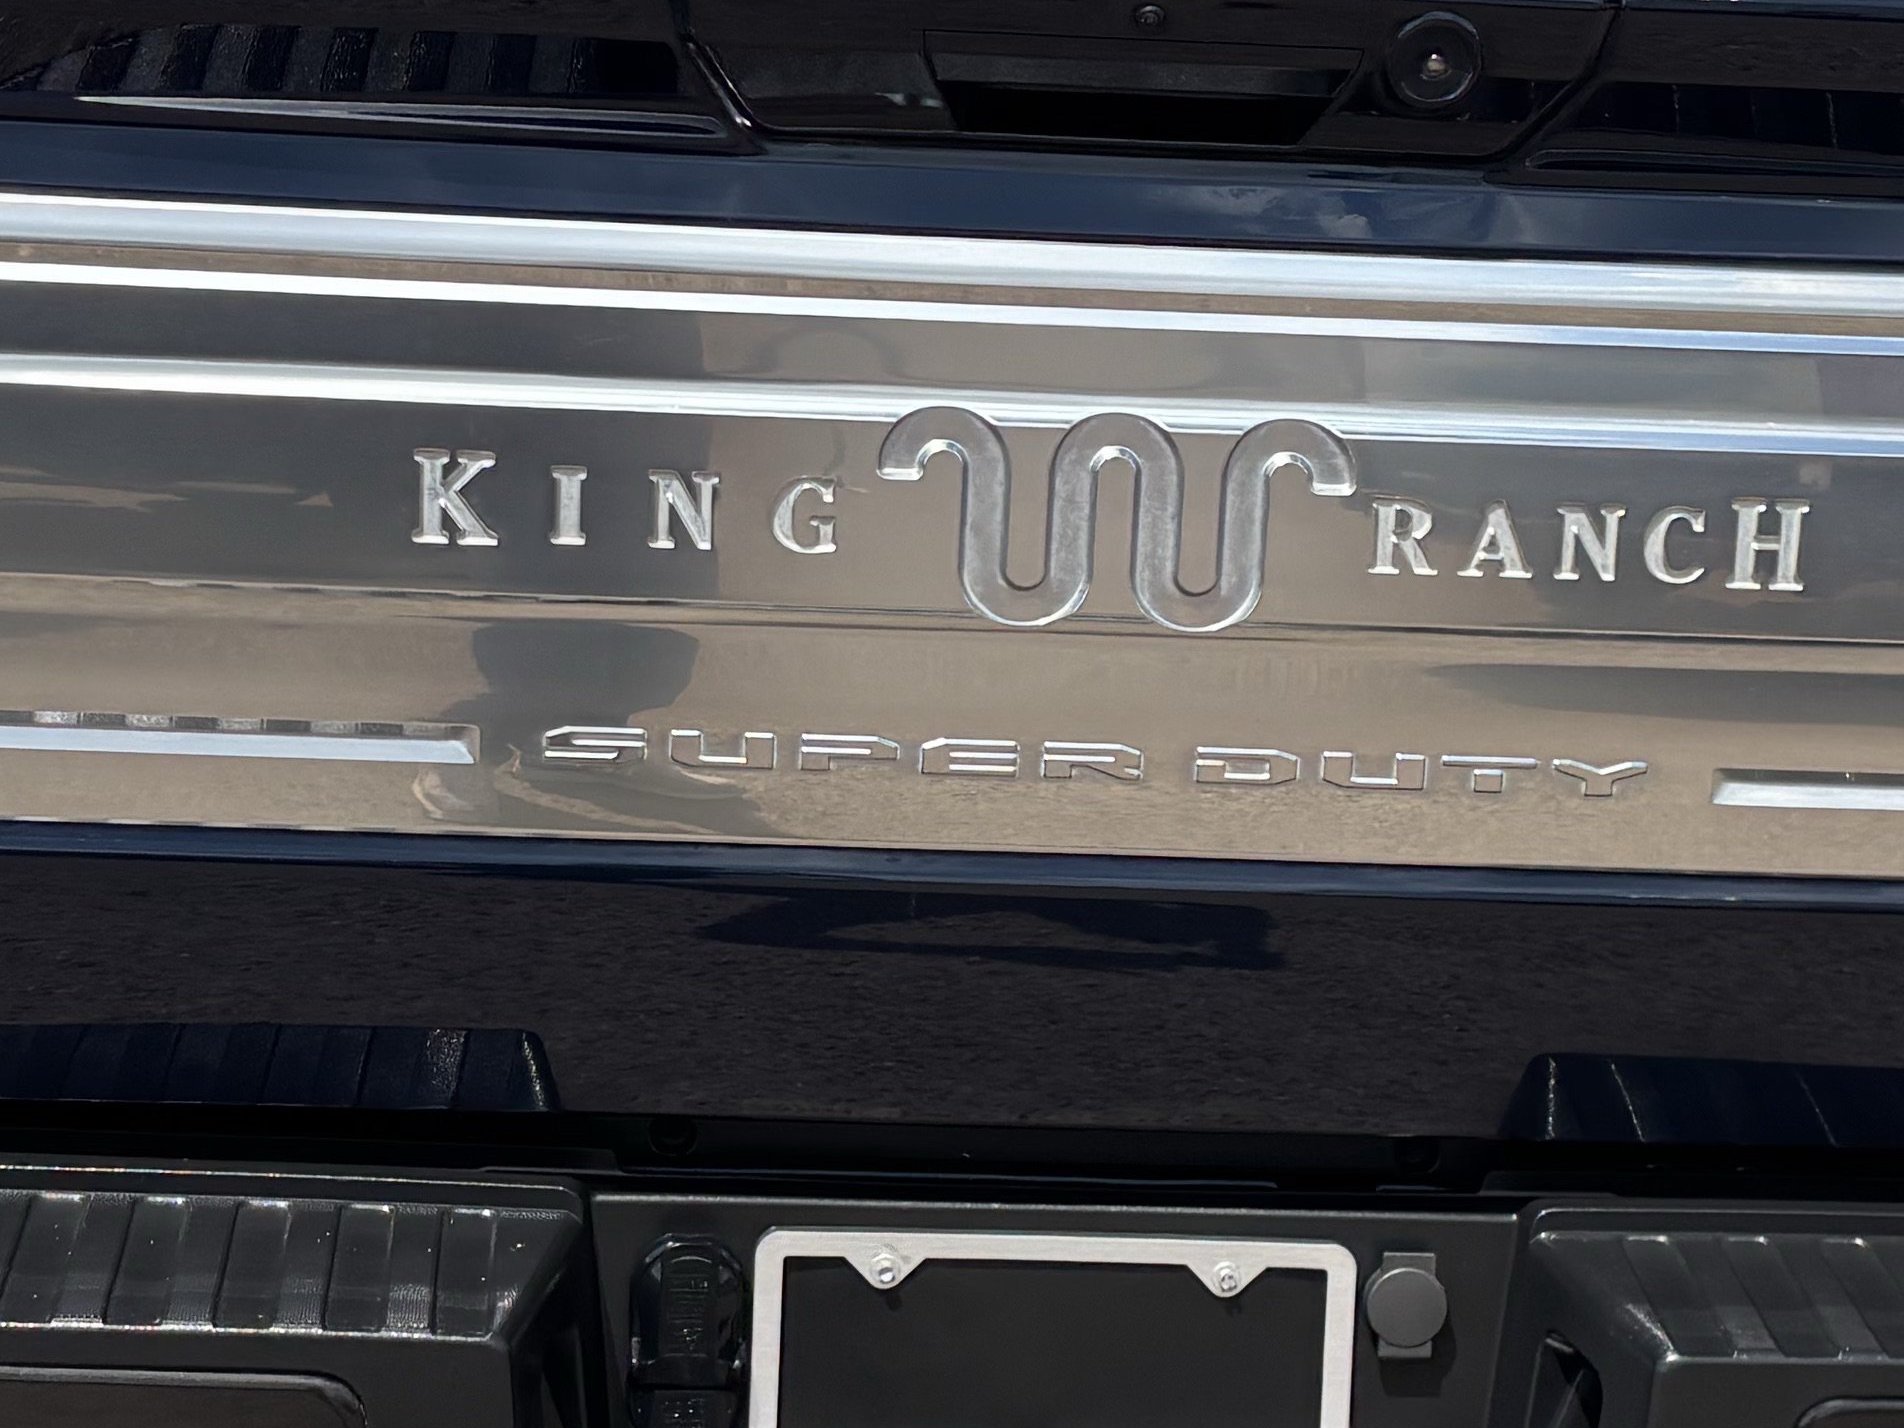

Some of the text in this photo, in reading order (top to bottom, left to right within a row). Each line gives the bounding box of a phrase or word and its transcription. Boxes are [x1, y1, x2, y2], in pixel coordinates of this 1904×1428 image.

[411, 447, 1811, 592] KING RANCH
[542, 725, 1649, 798] SUPER DUTY
